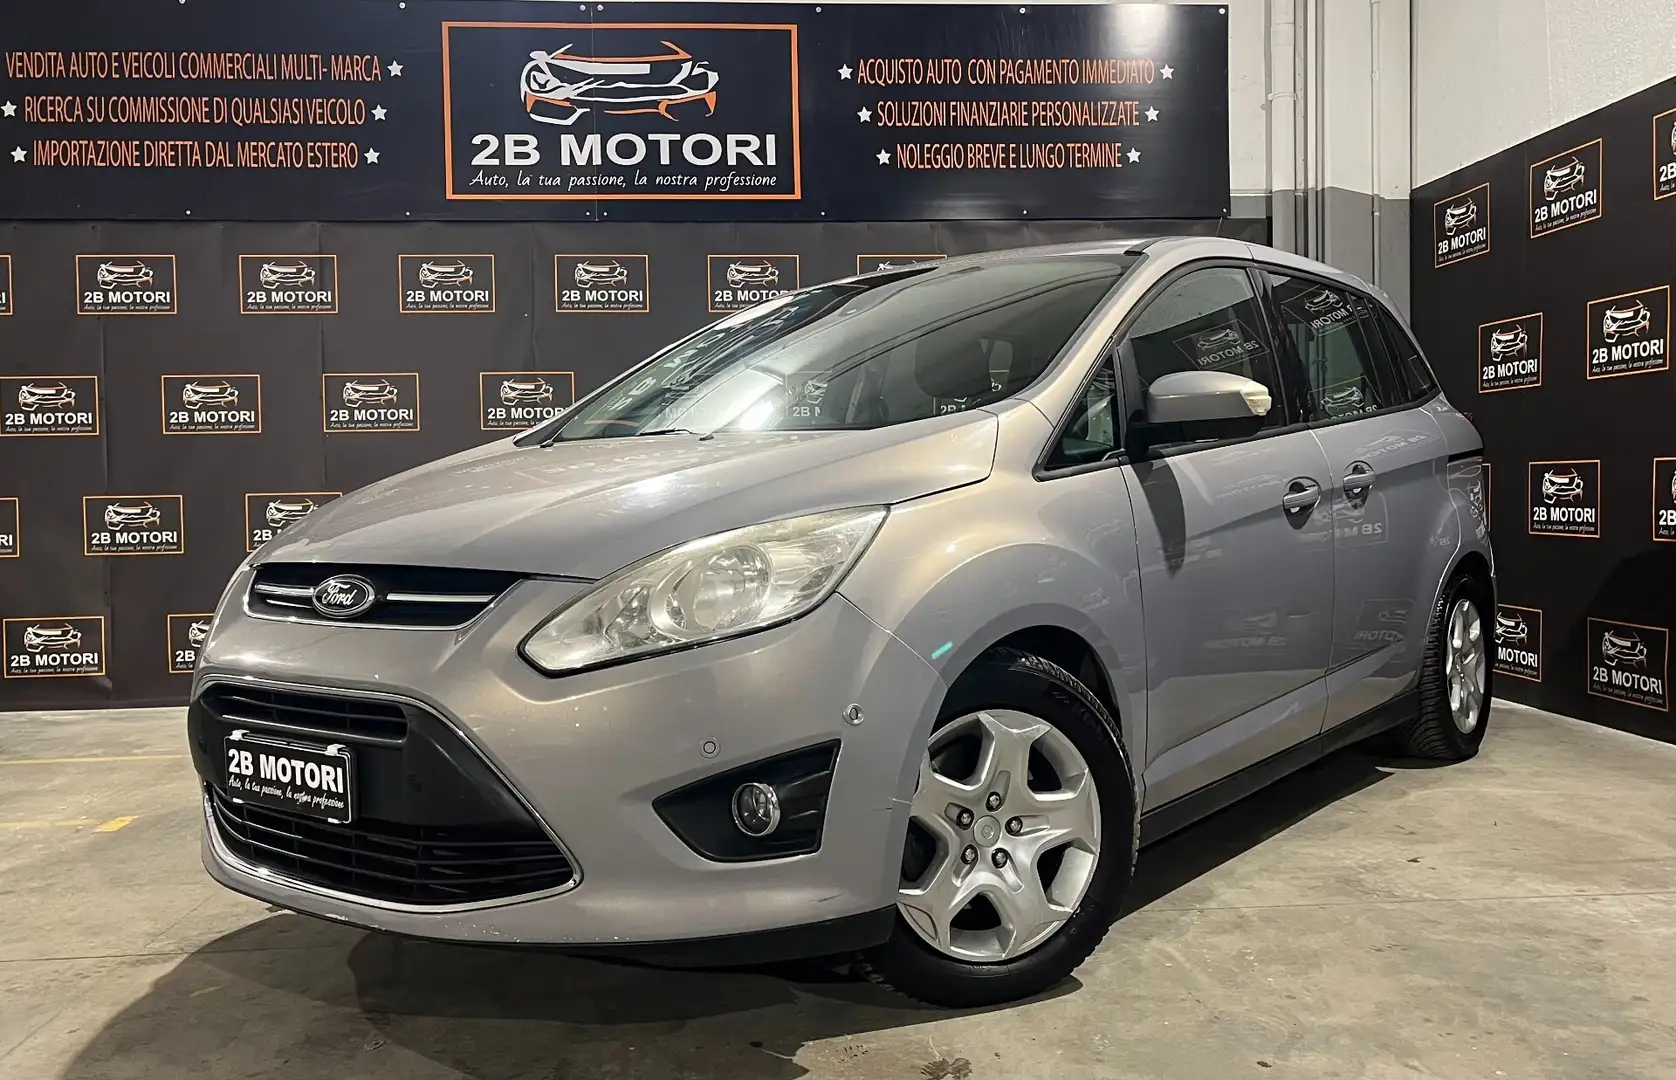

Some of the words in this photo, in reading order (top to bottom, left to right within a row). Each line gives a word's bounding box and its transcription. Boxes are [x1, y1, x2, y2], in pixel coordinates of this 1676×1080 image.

[6, 52, 66, 79] VENDITA
[69, 52, 109, 79] AUTO
[111, 53, 120, 80] E
[122, 53, 177, 80] VEICOLI
[179, 53, 278, 80] COMMERCIALI
[281, 54, 328, 80] MULTI-
[331, 55, 381, 81] MARCA
[858, 58, 923, 86] ACQUISTO
[927, 58, 962, 84] AUTO
[968, 58, 997, 84] CON
[1000, 58, 1079, 85] PAGAMENTO
[1082, 59, 1154, 84] IMMEDIATO
[24, 96, 83, 123] RICERCA
[86, 96, 105, 123] SU
[109, 96, 209, 124] COMMISSIONE
[213, 97, 228, 124] DI
[231, 98, 304, 127] QUALSIASI
[306, 98, 366, 125] VEICOLO
[877, 101, 946, 127] SOLUZIONI
[950, 101, 1028, 127] FINANZIARIE
[1031, 101, 1140, 127] PERSONALIZZATE
[33, 140, 140, 167] IMPORTAZIONE
[143, 141, 203, 168] DIRETTA
[205, 142, 234, 168] DAL
[237, 141, 304, 168] MERCATO
[307, 141, 359, 168] ESTERO
[471, 134, 540, 165] 2B
[561, 134, 776, 165] MOTORI
[896, 143, 964, 169] NOLEGGIO
[967, 143, 1006, 169] BREVE
[1009, 143, 1017, 169] E
[1020, 143, 1065, 169] LUNGO
[1066, 143, 1122, 169] TERMINE
[468, 169, 509, 188] Auto,
[517, 170, 531, 186] la
[538, 173, 561, 186] tua
[567, 172, 626, 191] passione,
[634, 169, 647, 186] la
[655, 173, 698, 186] nostra
[705, 171, 777, 191] professione
[1534, 206, 1548, 223] 2B
[1551, 189, 1597, 218] MOTORI
[1438, 240, 1449, 255] 2B
[1451, 227, 1486, 250] MOTORI
[84, 291, 104, 303] 2B
[108, 291, 170, 303] MOTORI
[247, 291, 266, 303] 2B
[272, 291, 331, 303] MOTORI
[406, 290, 425, 302] 2B
[430, 290, 489, 302] MOTORI
[562, 290, 581, 301] 2B
[585, 290, 643, 301] MOTORI
[714, 290, 733, 301] 2B
[737, 290, 792, 301] MOTO
[1592, 348, 1608, 364] 2B
[1612, 338, 1664, 361] MOTORI
[1483, 366, 1496, 380] 2B
[1498, 359, 1537, 376] MOTORI
[5, 413, 25, 425] 2B
[30, 413, 92, 425] MOTORI
[169, 411, 189, 422] 2B
[194, 411, 255, 422] MOTORI
[330, 410, 349, 421] 2B
[354, 409, 413, 421] MOTORI
[488, 408, 506, 419] 2B
[511, 408, 568, 418] MOTOR
[1534, 507, 1547, 520] 2B
[1550, 507, 1595, 522] MOTORI
[91, 532, 111, 544] 2B
[116, 531, 177, 544] MOTORI
[253, 530, 272, 541] 2B
[322, 580, 357, 605] Ford
[10, 655, 31, 667] 2B
[36, 652, 98, 666] MOTORI
[175, 650, 196, 662] 2B
[1498, 646, 1538, 668] MOTORI
[1592, 666, 1608, 683] 2B
[1612, 669, 1662, 694] MOTORI
[228, 748, 254, 776] 2B
[260, 754, 344, 793] MOTORI
[228, 774, 242, 790] Auto,
[245, 778, 250, 790] la
[252, 781, 260, 791] tua
[286, 786, 292, 799] la
[313, 793, 344, 809] professione
